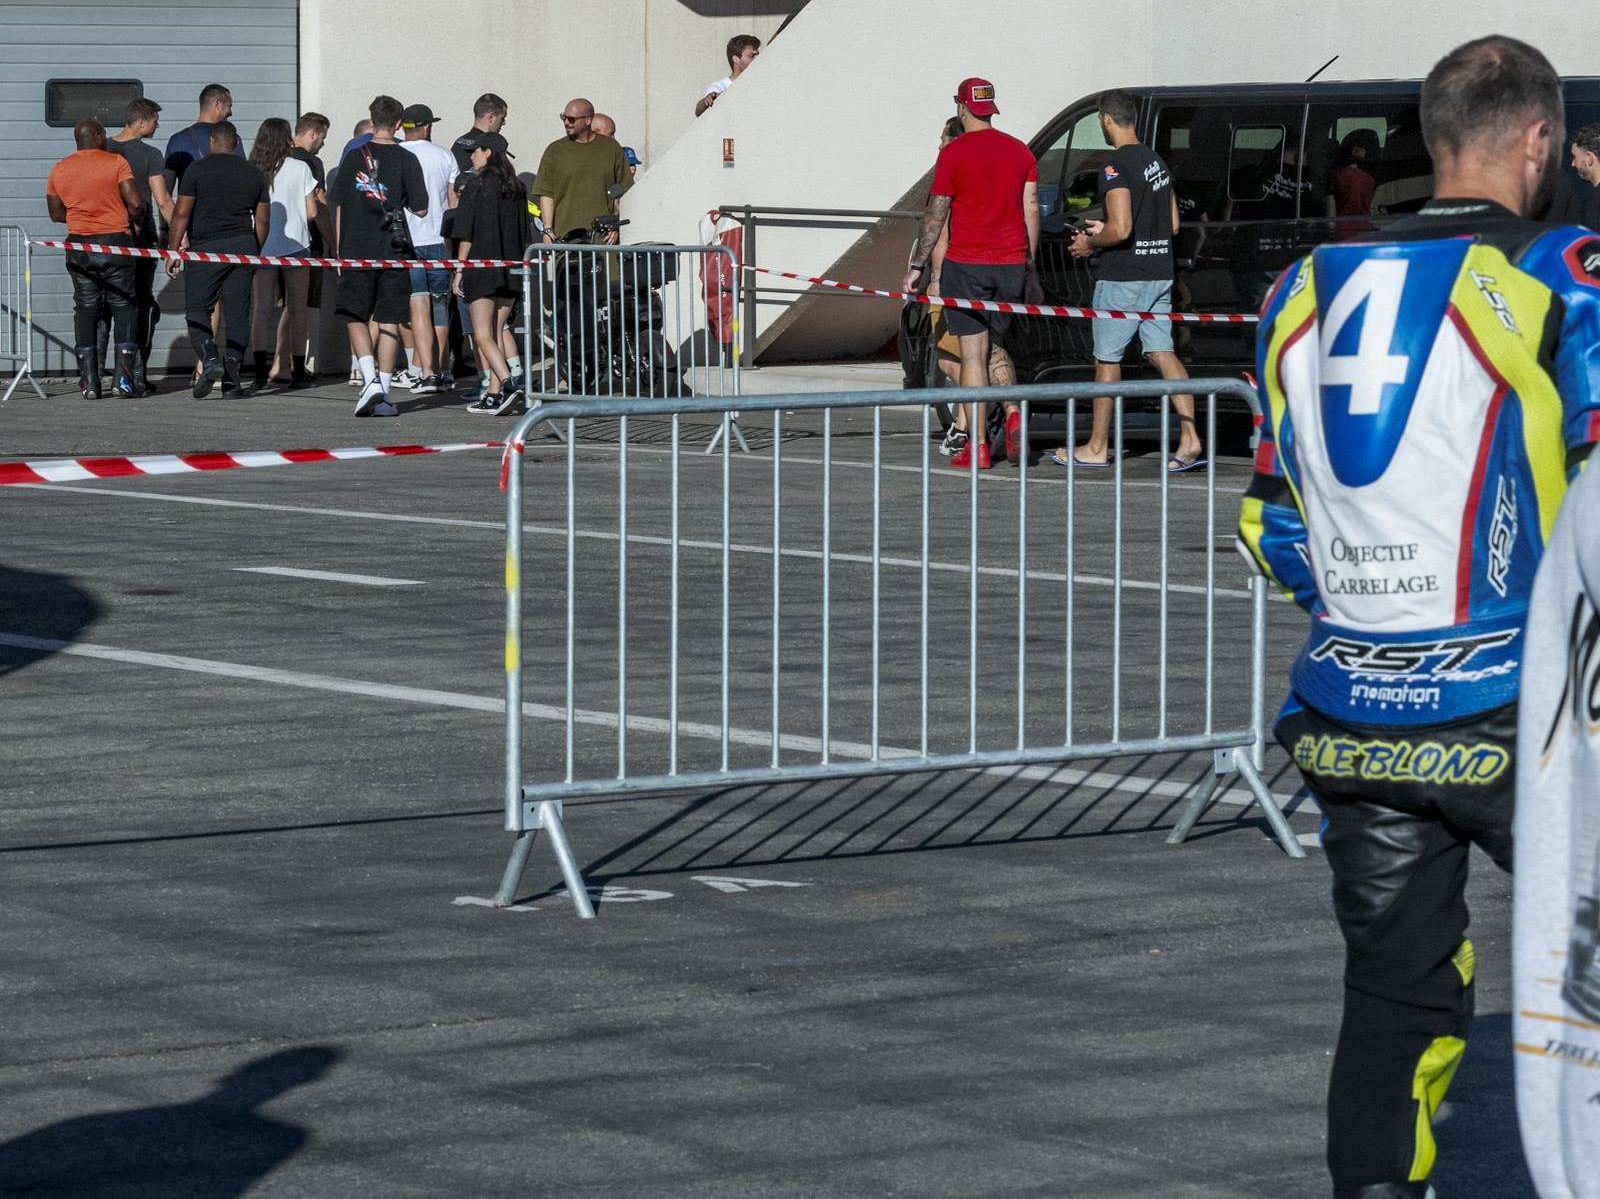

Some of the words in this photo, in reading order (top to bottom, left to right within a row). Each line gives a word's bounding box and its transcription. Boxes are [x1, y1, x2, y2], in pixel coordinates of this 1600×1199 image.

[1319, 258, 1410, 416] 4
[1486, 473, 1514, 599] RST
[1309, 628, 1521, 674] RST
